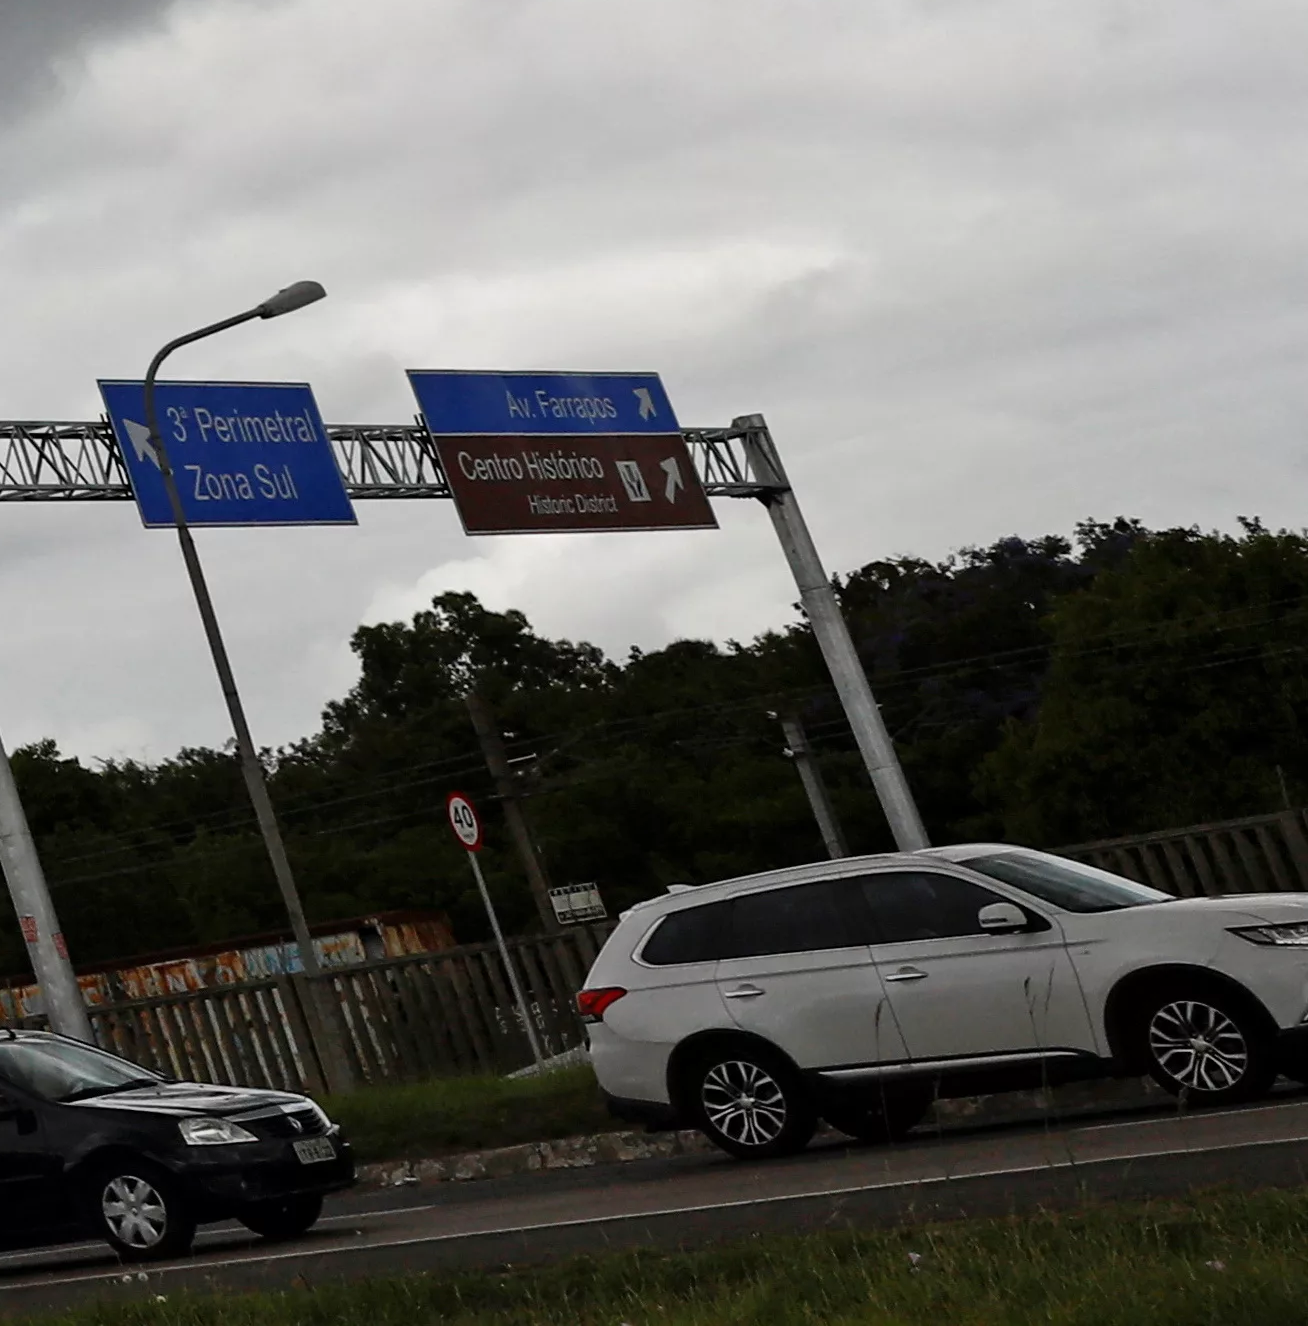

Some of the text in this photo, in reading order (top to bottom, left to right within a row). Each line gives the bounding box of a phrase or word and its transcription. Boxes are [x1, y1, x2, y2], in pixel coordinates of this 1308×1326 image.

[506, 390, 617, 424] Av. Farrapos
[194, 407, 318, 443] Perimetral
[457, 450, 604, 481] Centro Histórico
[184, 463, 298, 501] Zona Sul
[527, 493, 618, 515] Historic District
[454, 805, 474, 828] 40
